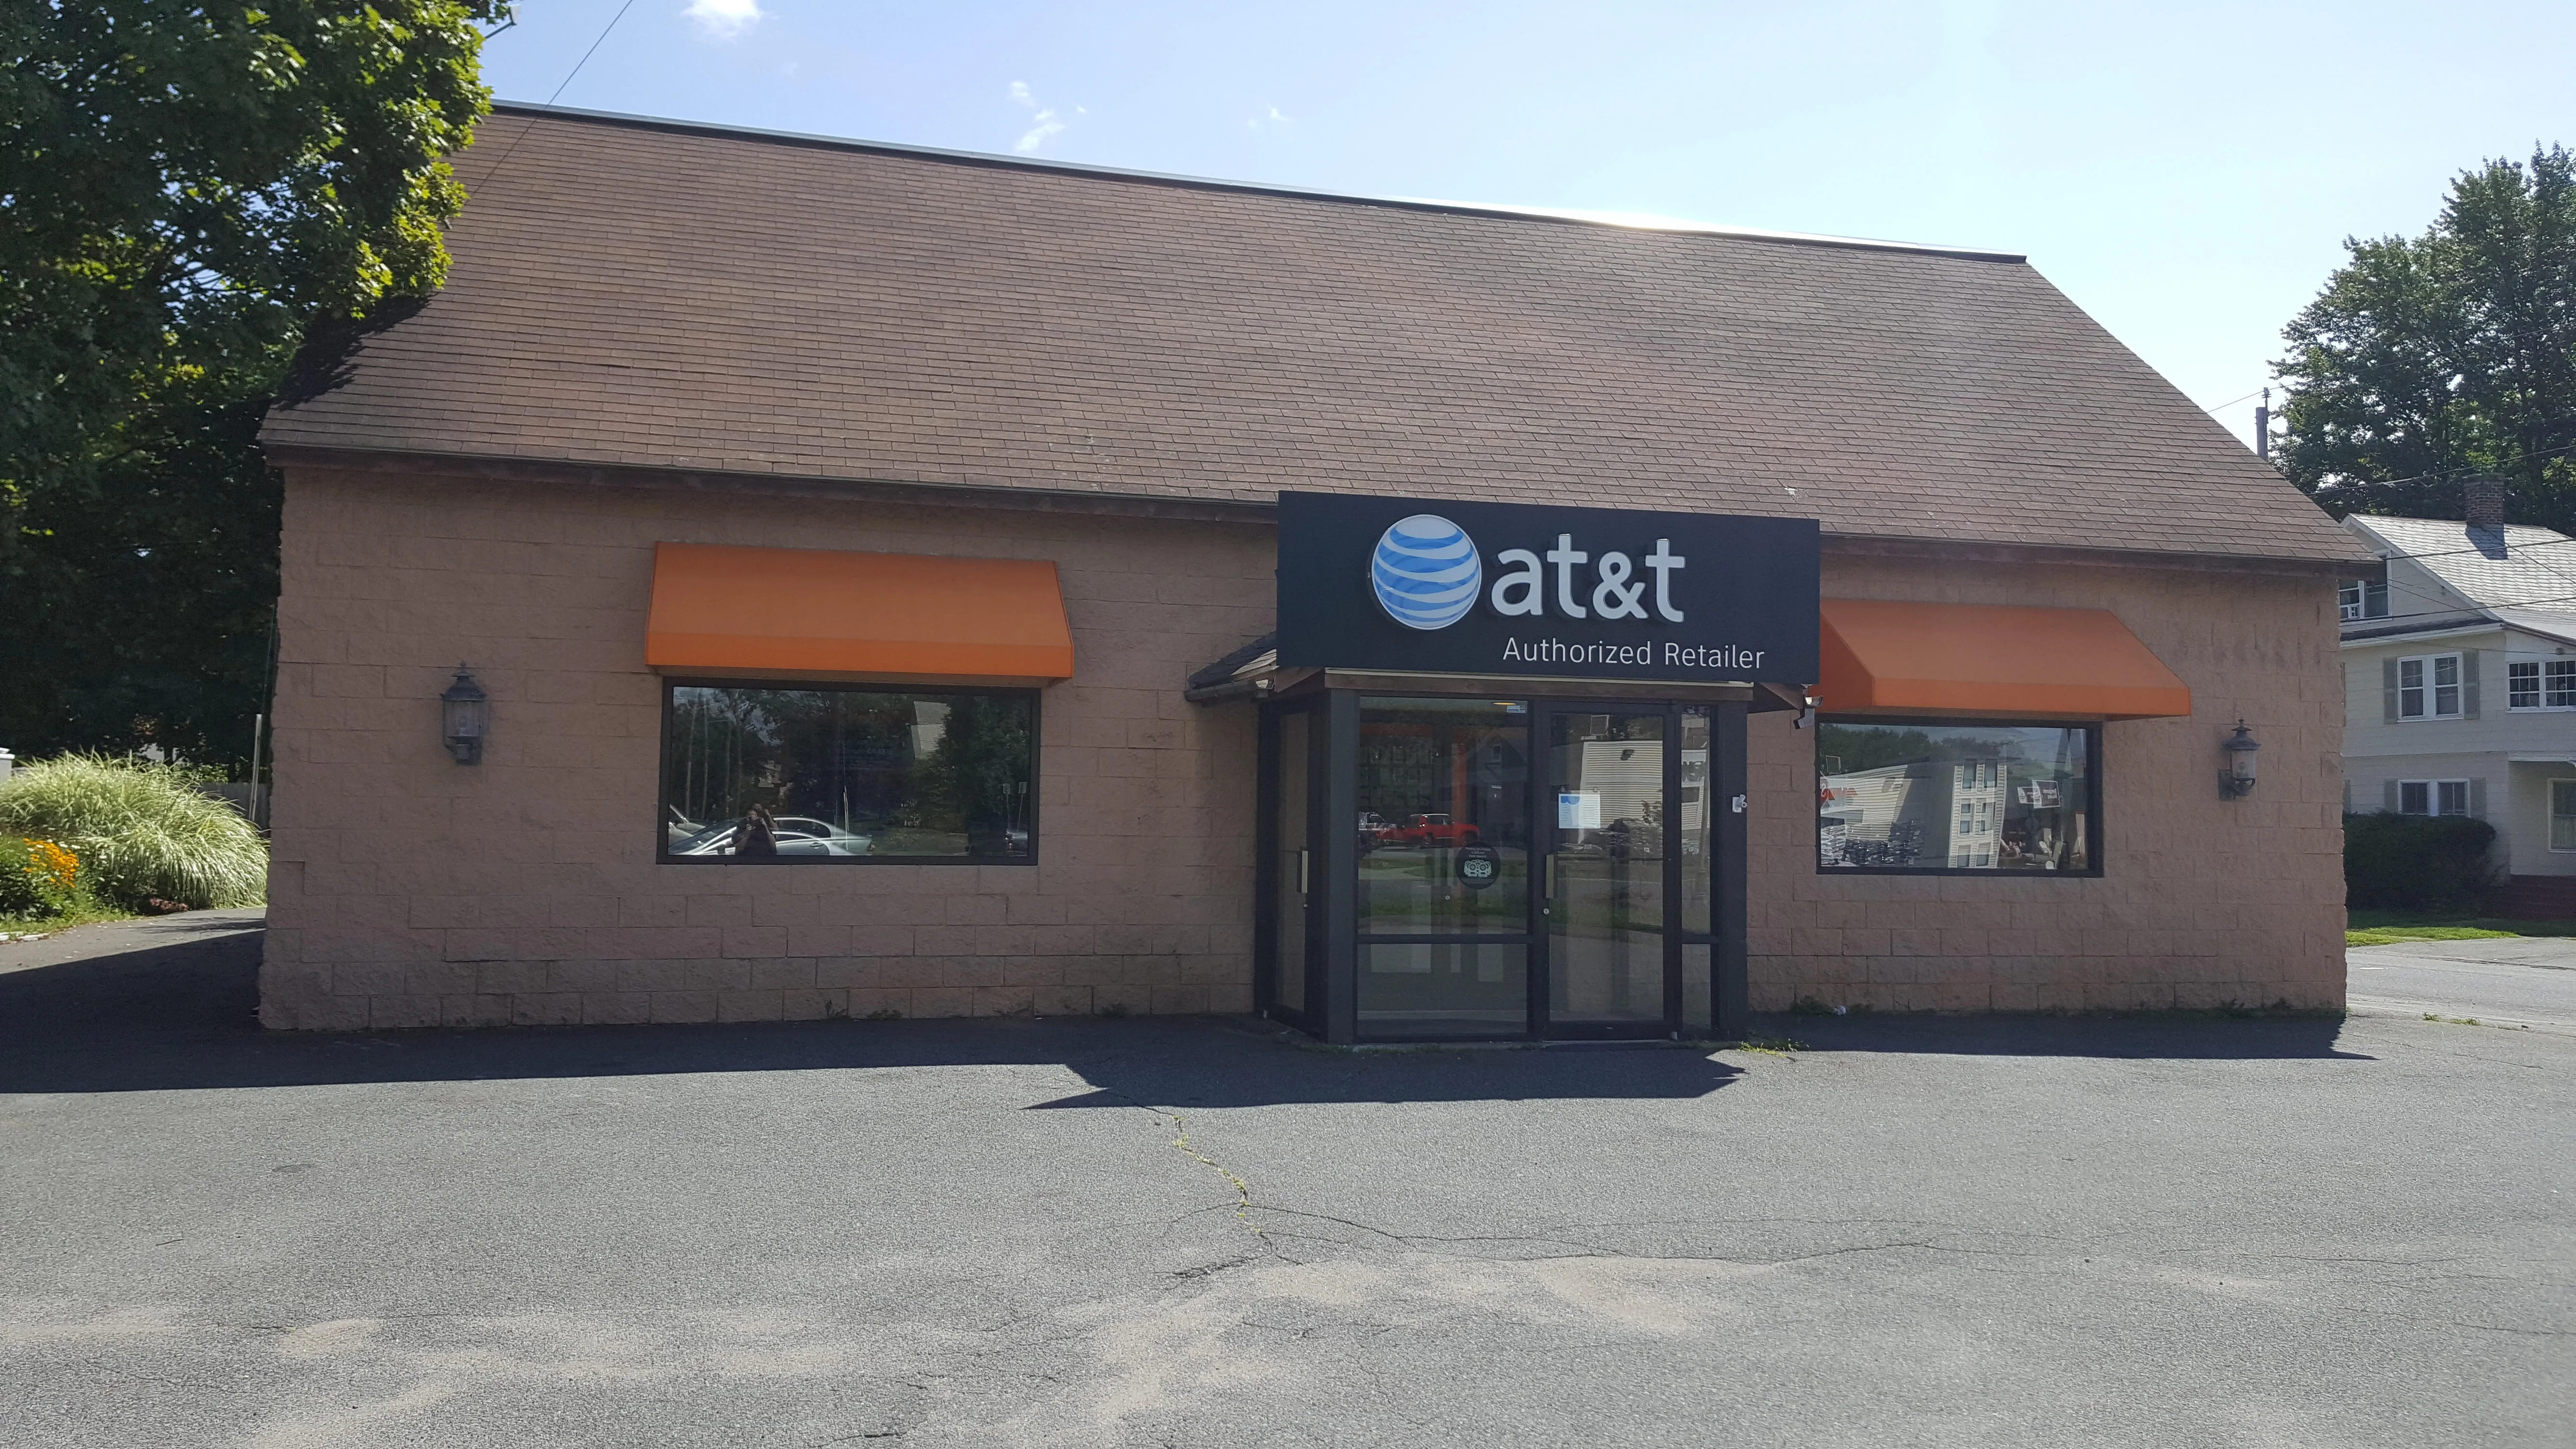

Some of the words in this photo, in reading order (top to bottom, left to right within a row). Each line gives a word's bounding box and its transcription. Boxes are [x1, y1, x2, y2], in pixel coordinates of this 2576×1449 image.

[1491, 534, 1685, 623] at&t
[1502, 637, 1651, 664] Authorized
[1665, 643, 1765, 669] Retailer
